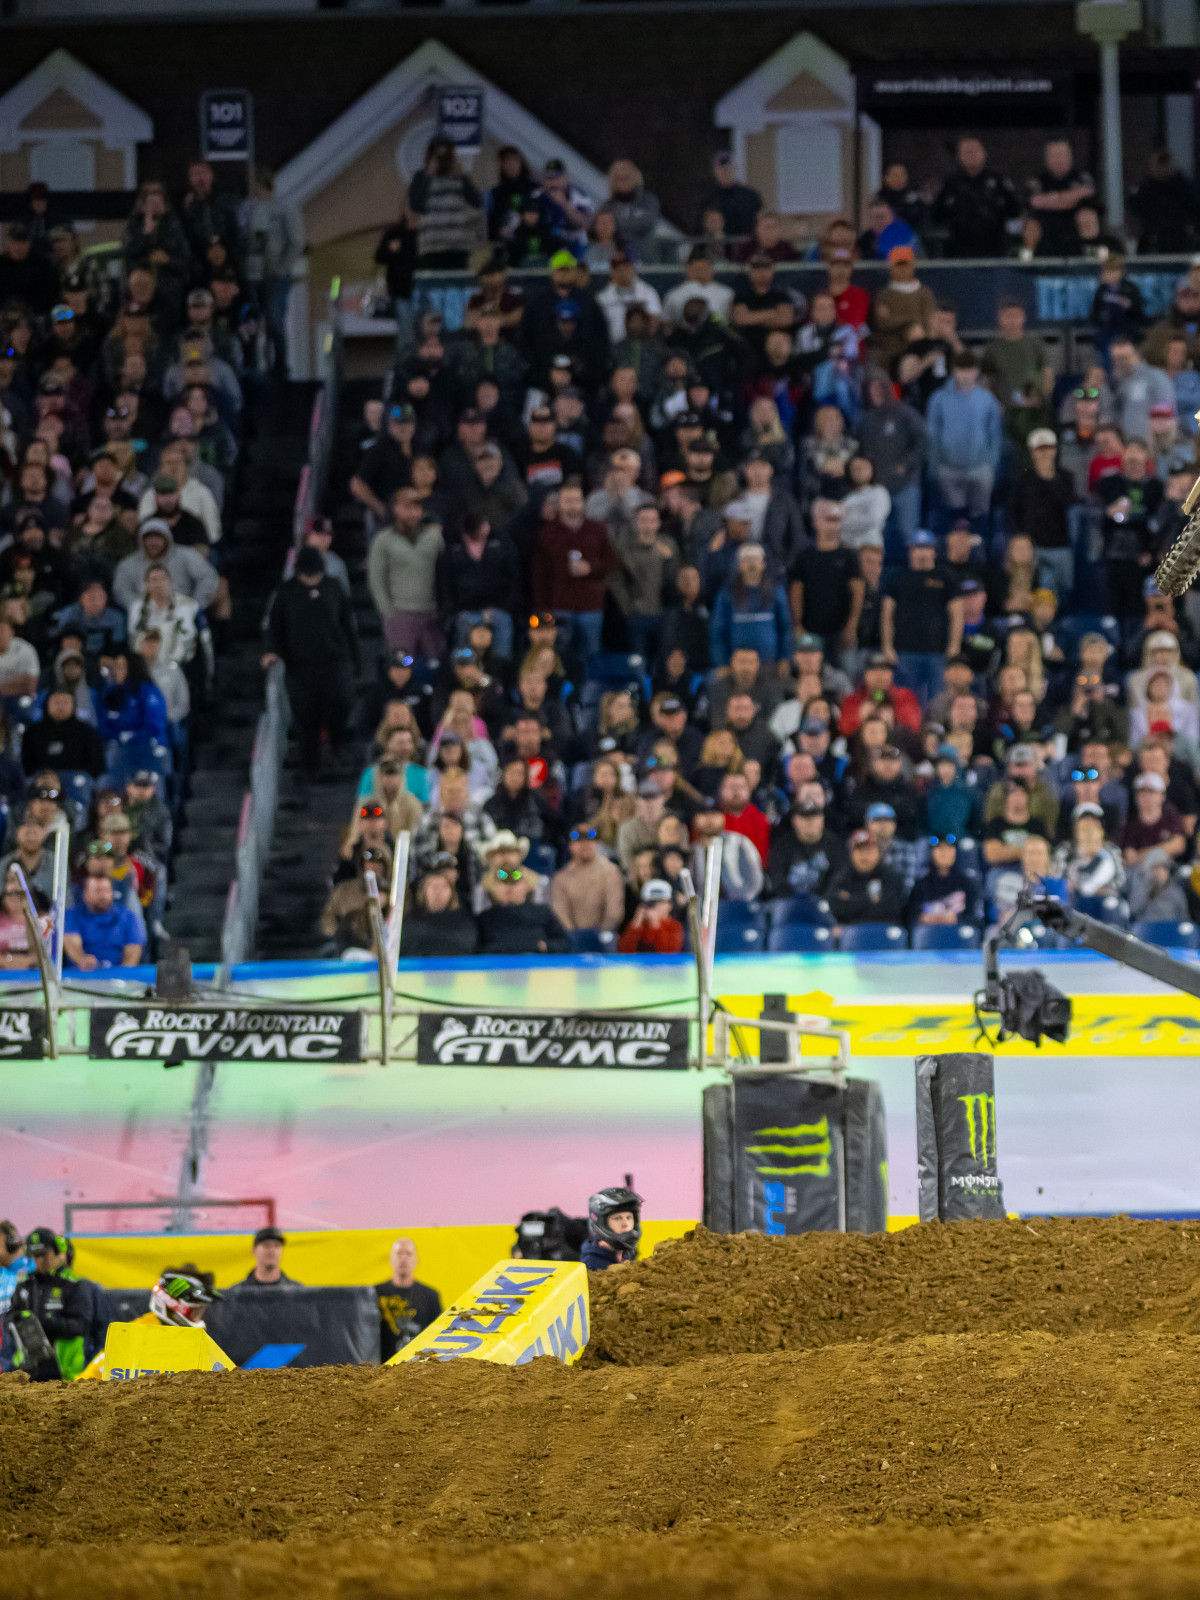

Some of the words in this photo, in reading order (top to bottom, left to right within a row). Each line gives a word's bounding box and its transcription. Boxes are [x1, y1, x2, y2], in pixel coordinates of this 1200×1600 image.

[210, 102, 243, 122] 101
[443, 97, 479, 117] 102
[144, 1010, 219, 1032] ROCKY
[219, 1011, 344, 1034] MOUNTAIN
[471, 1015, 547, 1036] ROCKY
[547, 1018, 672, 1040] MOUNTAIN
